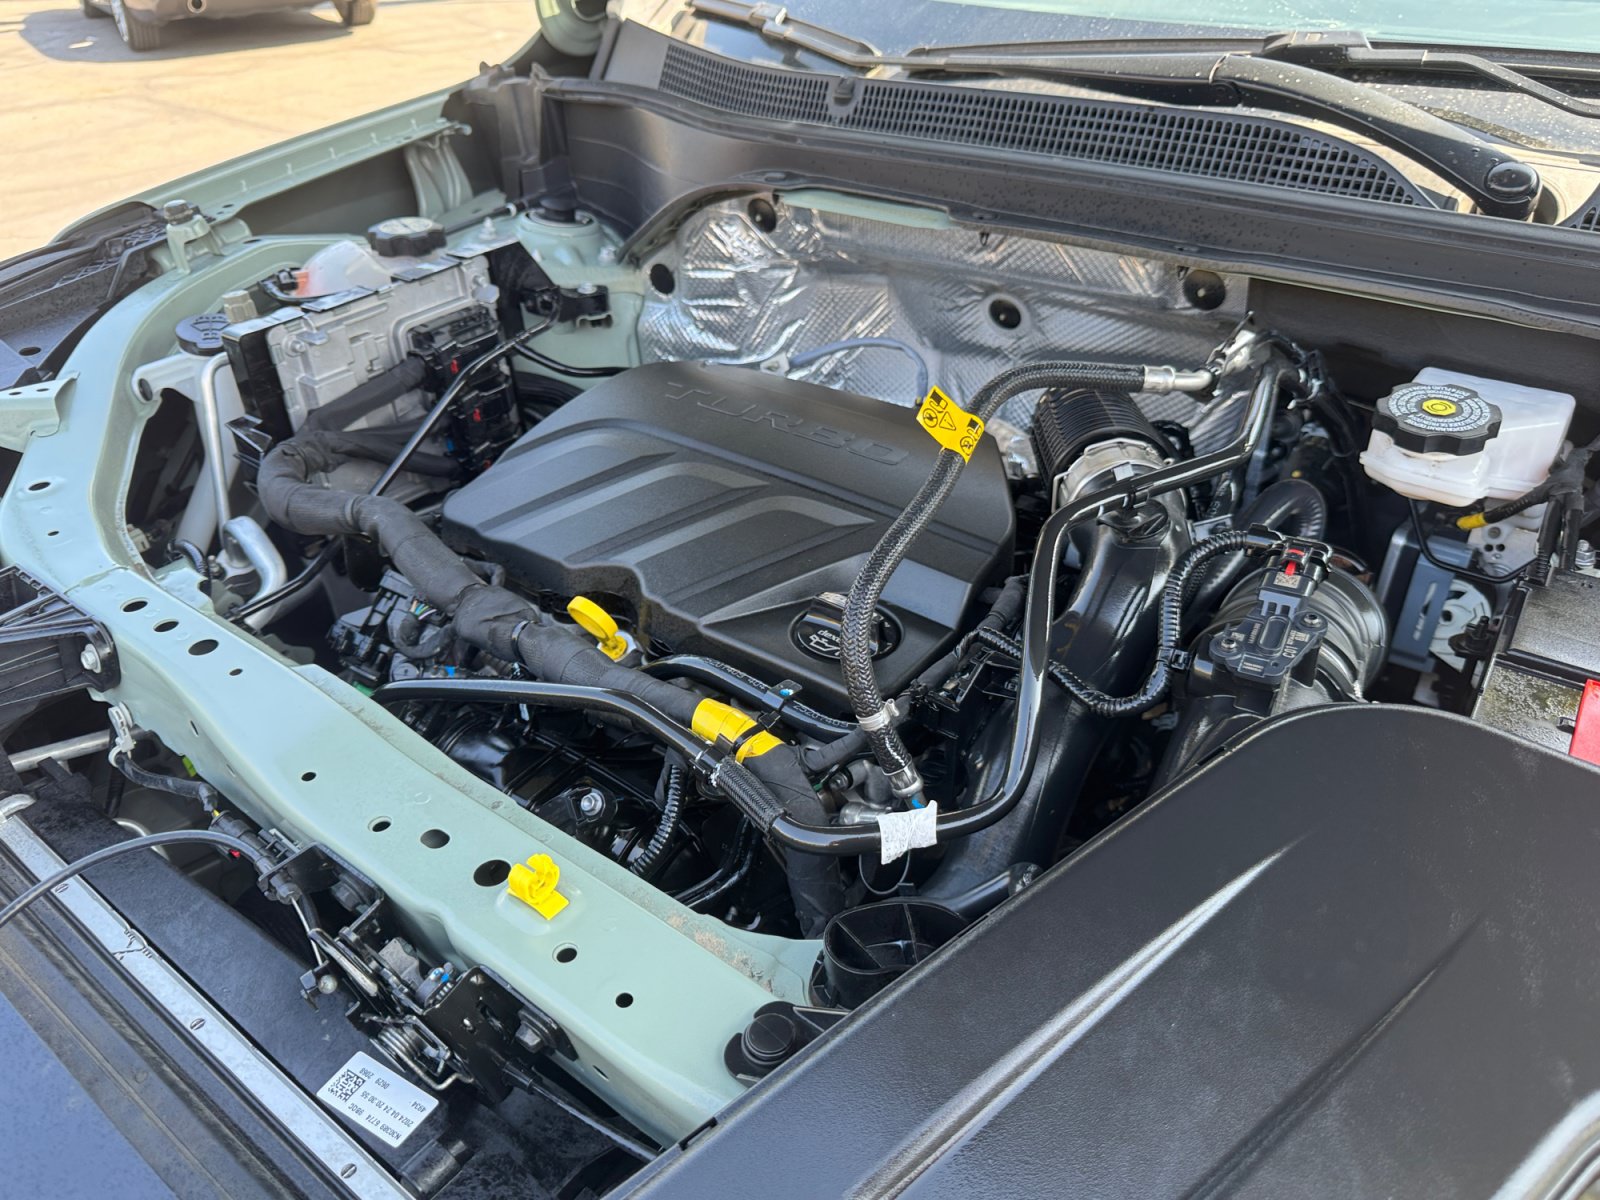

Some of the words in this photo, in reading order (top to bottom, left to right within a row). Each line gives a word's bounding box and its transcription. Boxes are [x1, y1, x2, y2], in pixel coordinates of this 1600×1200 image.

[665, 381, 910, 466] TURBO
[411, 1101, 426, 1113] 4934
[365, 1114, 380, 1126] 6774
